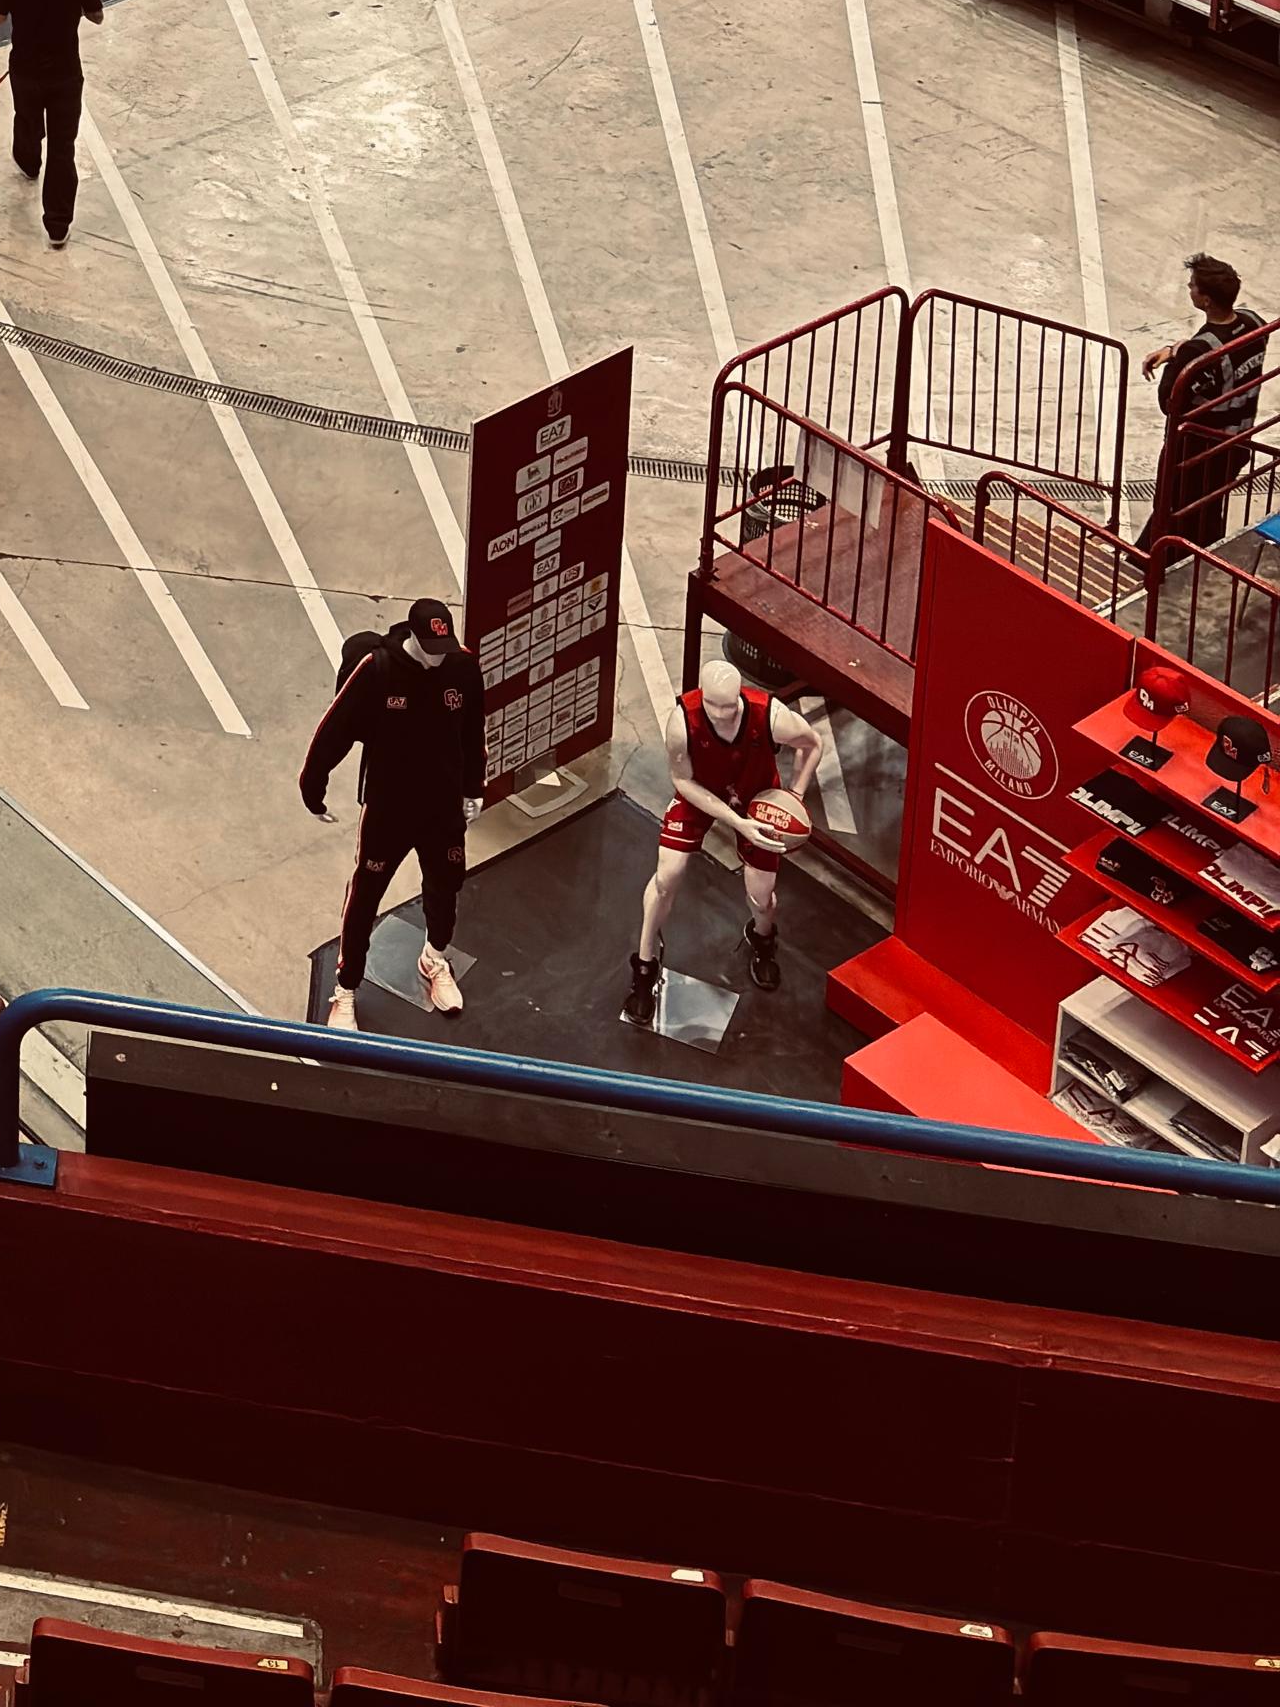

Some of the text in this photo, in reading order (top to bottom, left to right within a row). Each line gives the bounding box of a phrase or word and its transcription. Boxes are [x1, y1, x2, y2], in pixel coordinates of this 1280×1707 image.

[540, 420, 567, 444] EA7
[490, 534, 515, 557] AON
[536, 556, 557, 575] EA7
[987, 694, 1041, 736] OLIMPIA
[1128, 749, 1154, 766] EA7
[983, 758, 1033, 796] MILANO
[755, 803, 792, 822] OLIMPIA
[1211, 799, 1238, 817] EA7
[755, 811, 790, 829] MILANO
[931, 787, 1072, 909] EA7
[929, 839, 1062, 935] EMPORIO ARMAN
